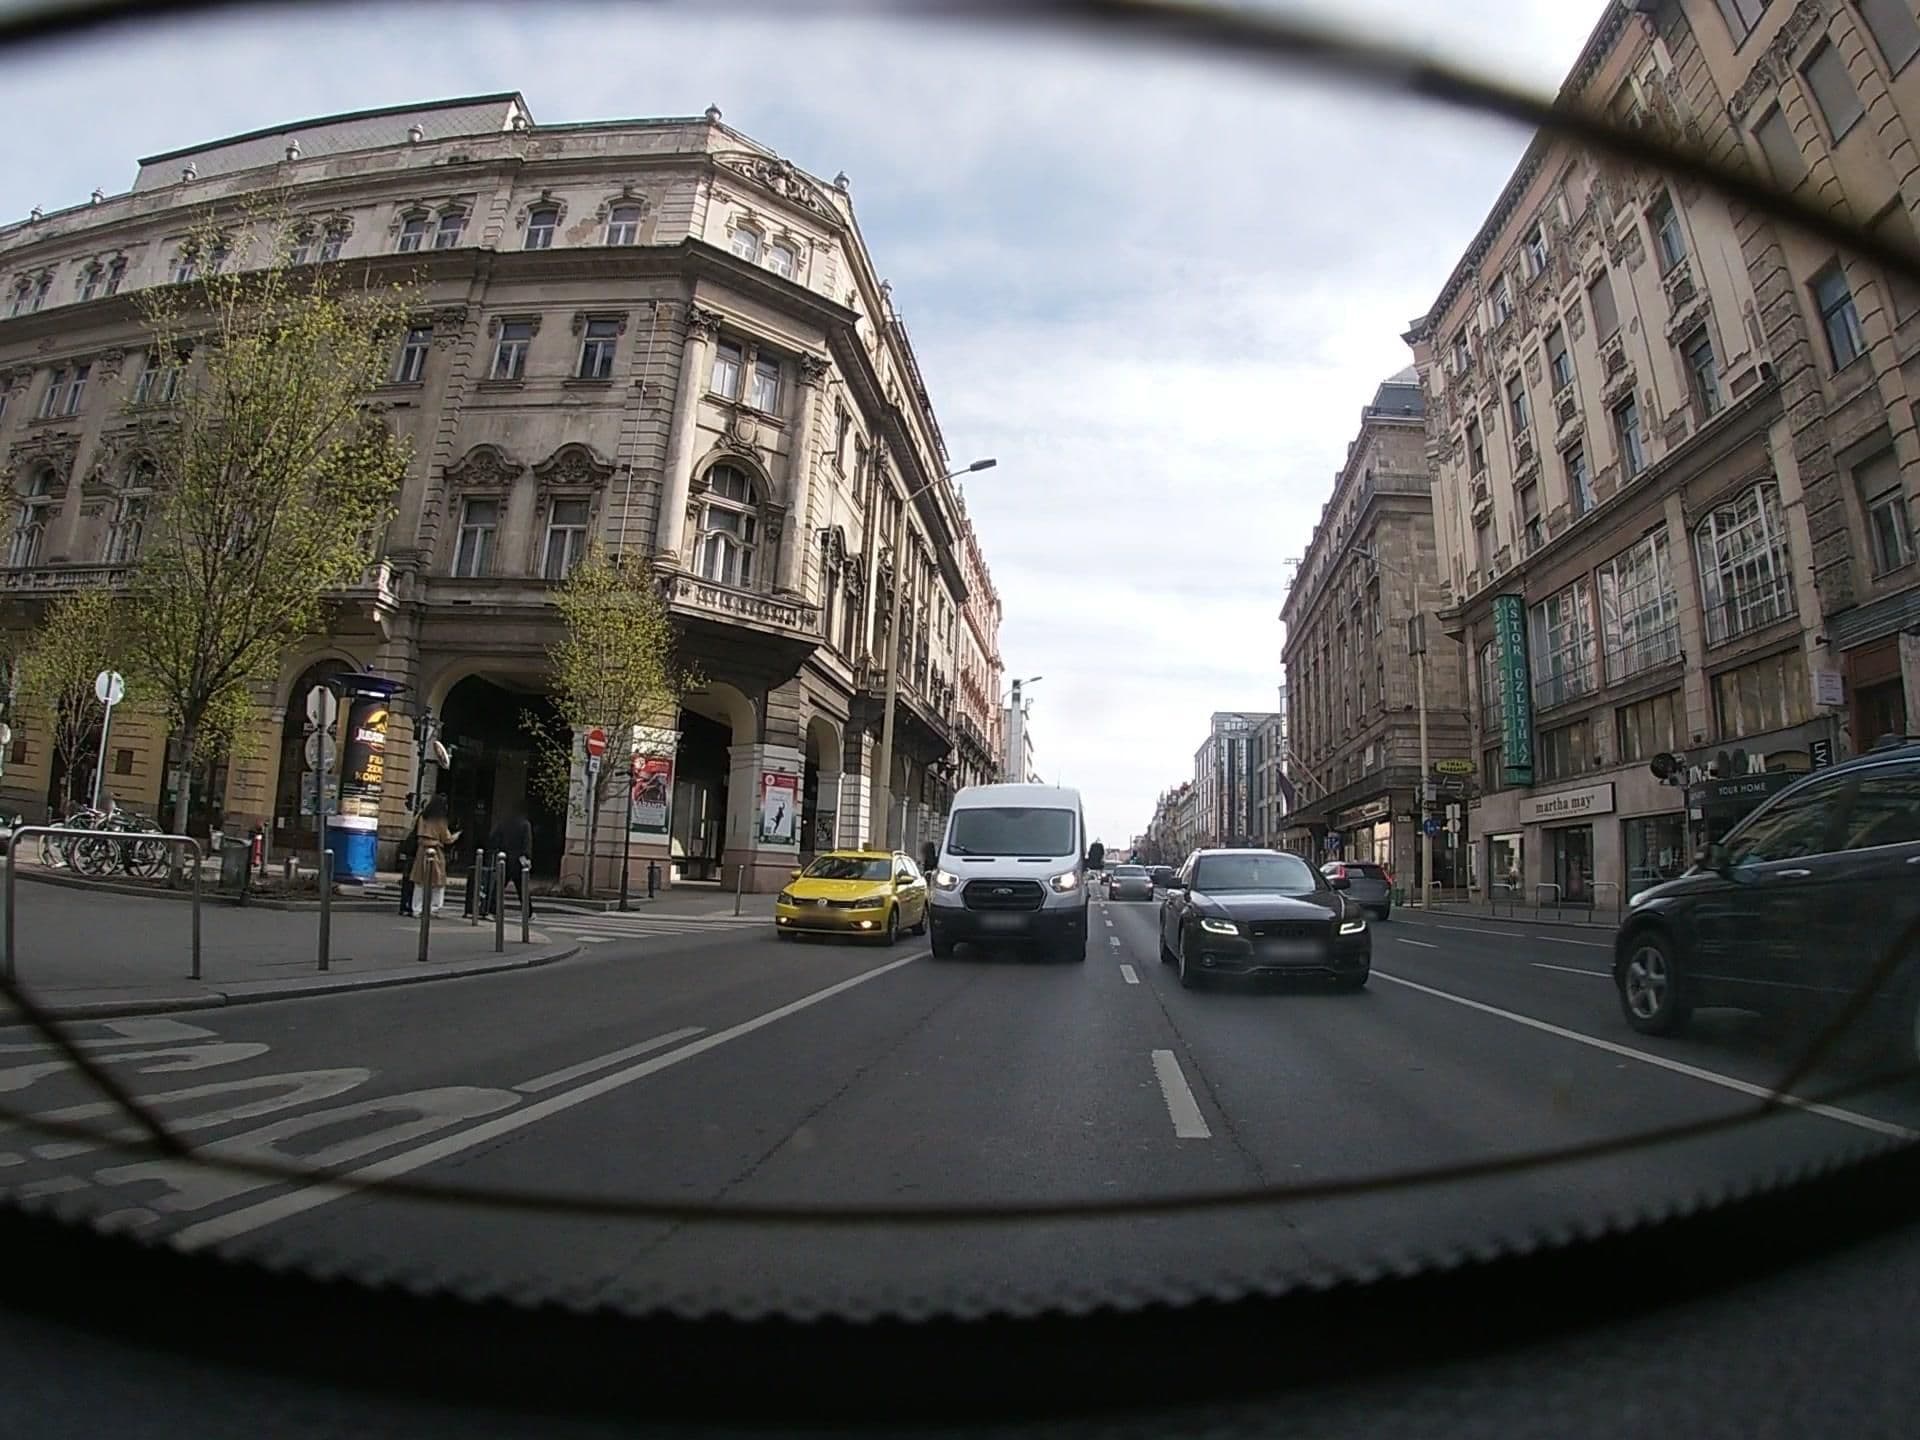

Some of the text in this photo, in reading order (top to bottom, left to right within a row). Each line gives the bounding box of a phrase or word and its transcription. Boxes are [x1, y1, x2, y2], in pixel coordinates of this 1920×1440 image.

[1508, 598, 1521, 656] ASTOR
[1719, 784, 1738, 795] YOUR
[1741, 782, 1767, 793] HOME
[1536, 797, 1569, 814] martha
[1571, 796, 1591, 809] may
